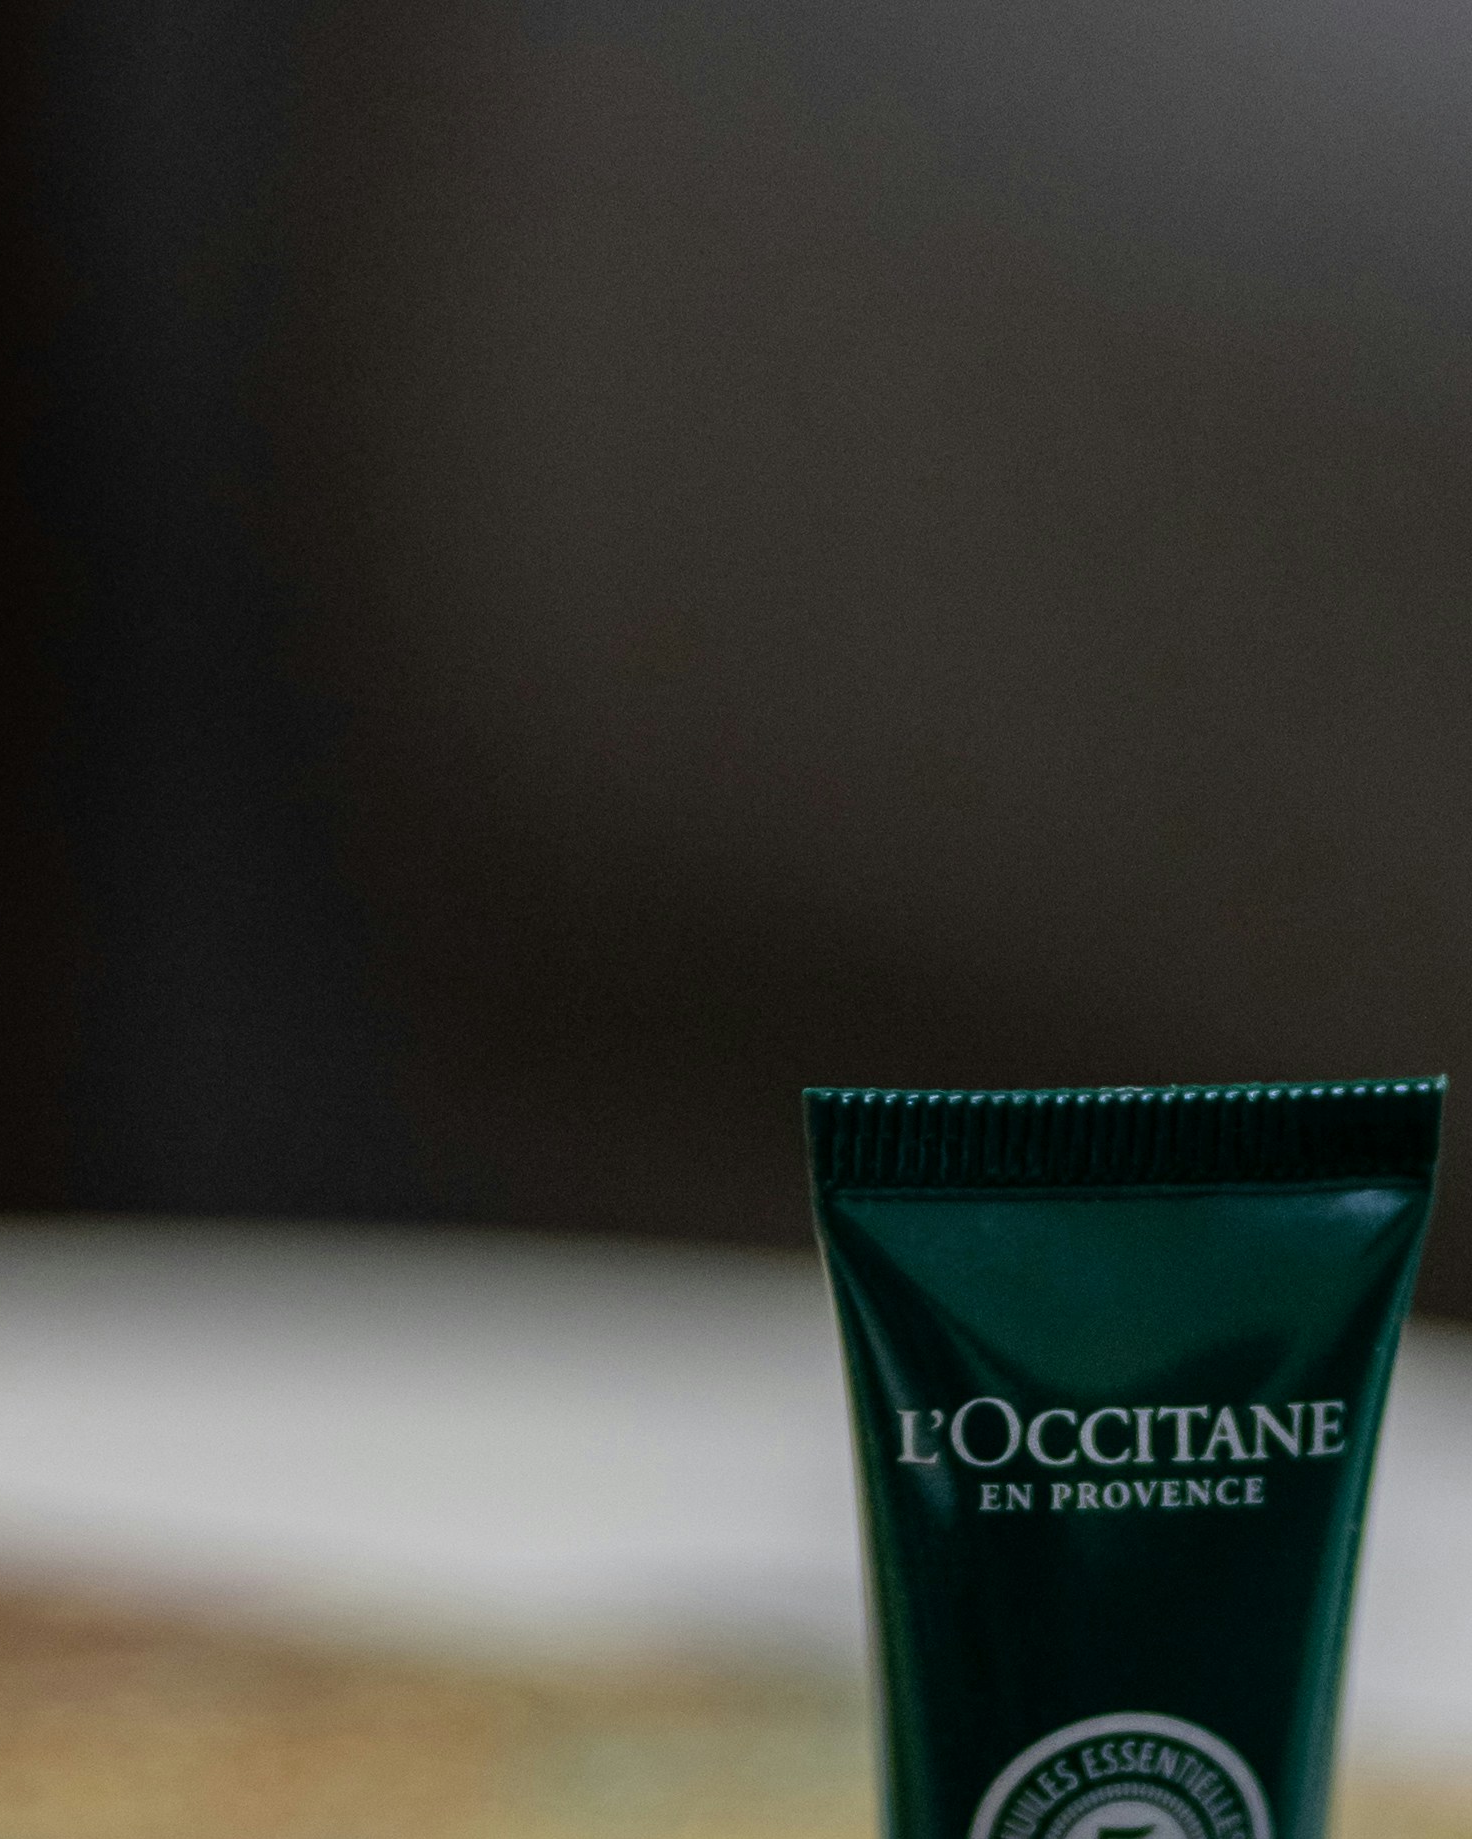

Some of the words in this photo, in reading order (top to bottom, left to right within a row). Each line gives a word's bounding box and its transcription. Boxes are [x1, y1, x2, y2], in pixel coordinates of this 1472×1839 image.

[897, 1397, 1346, 1467] L'OCCITANE
[979, 1484, 1033, 1511] EN
[1051, 1477, 1265, 1510] PROVENCE
